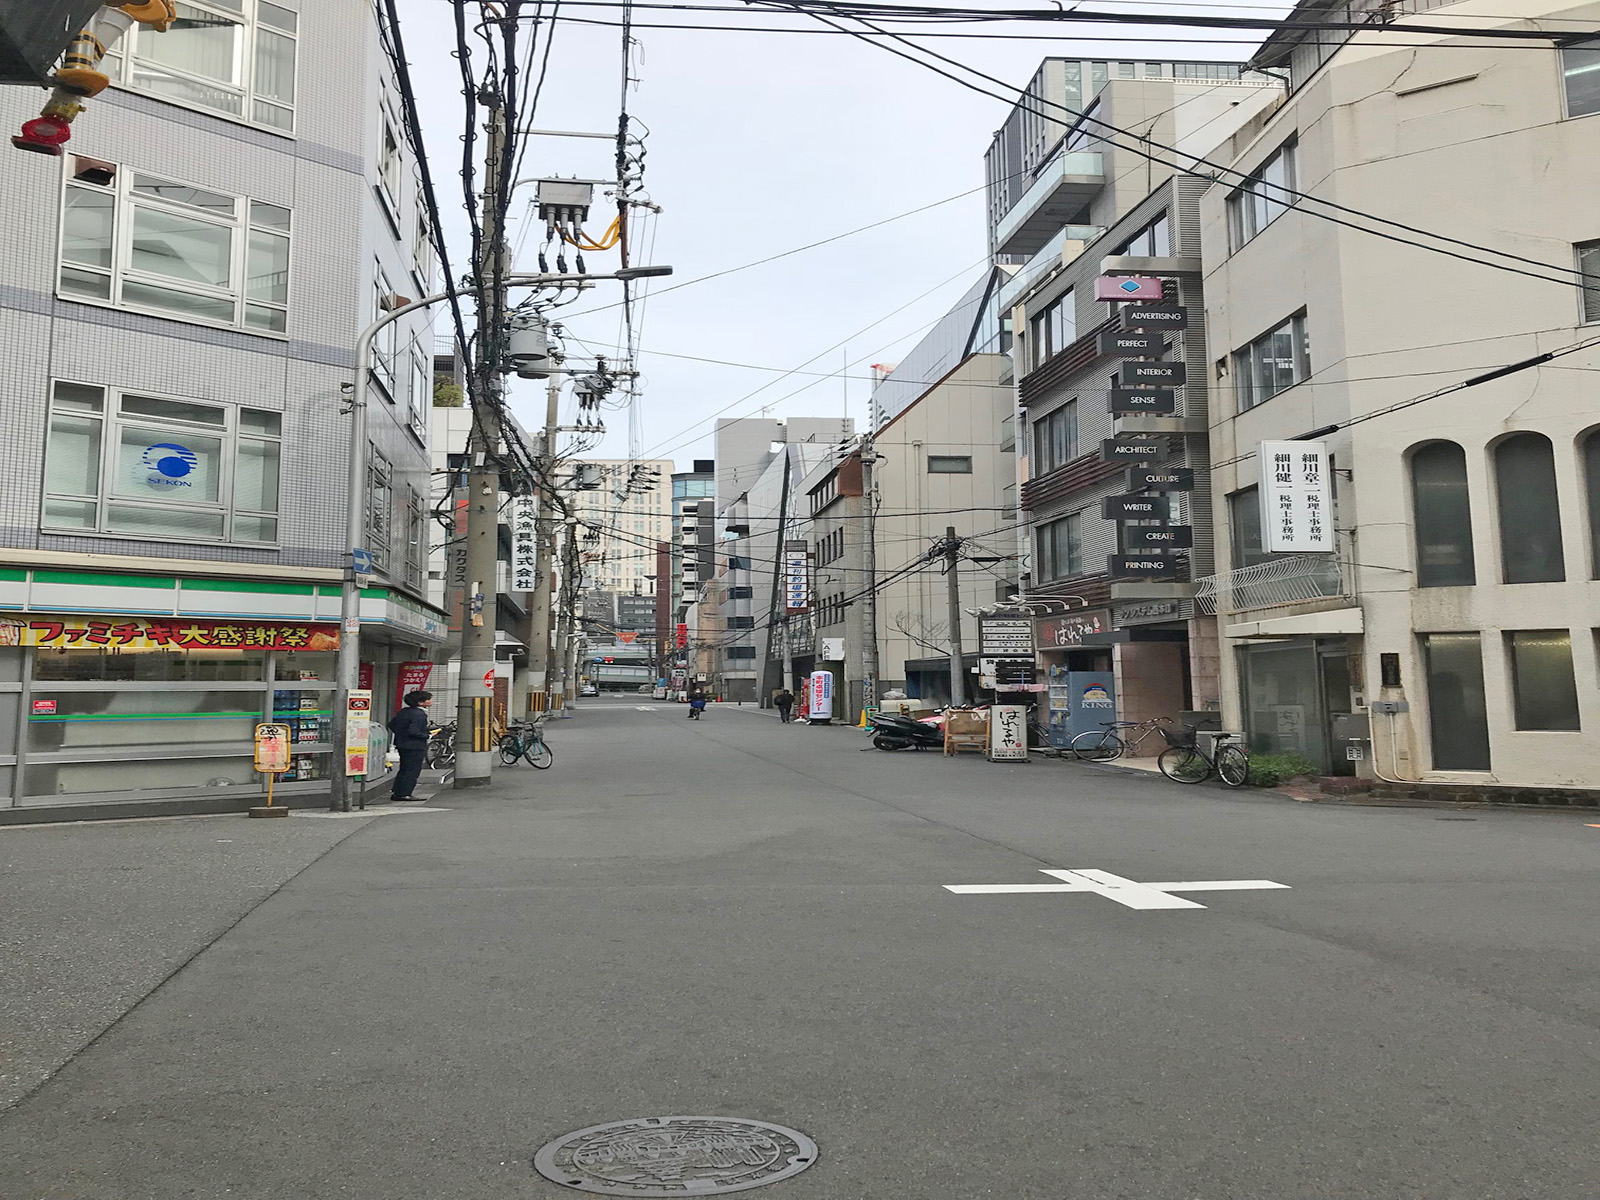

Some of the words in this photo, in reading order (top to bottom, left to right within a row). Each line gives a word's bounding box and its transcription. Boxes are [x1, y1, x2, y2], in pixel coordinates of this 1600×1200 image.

[1131, 311, 1182, 320] ADVERTISING
[1136, 368, 1173, 376] INTERIOR
[1130, 396, 1156, 404] SENSE
[1114, 446, 1157, 454] ARCHITECT
[1274, 453, 1293, 489] 細川健一
[148, 477, 193, 487] SEKON
[1145, 474, 1179, 483] CULTURE
[1123, 503, 1153, 511] WRITER
[1279, 494, 1294, 541] 税理士事務所
[1307, 494, 1322, 542] 税理士事務所
[1145, 532, 1175, 541] CREATE
[515, 499, 534, 589] 中央漁具株式会社
[1125, 561, 1164, 569] PRINTING
[29, 621, 312, 648] ファミチキ大感謝祭
